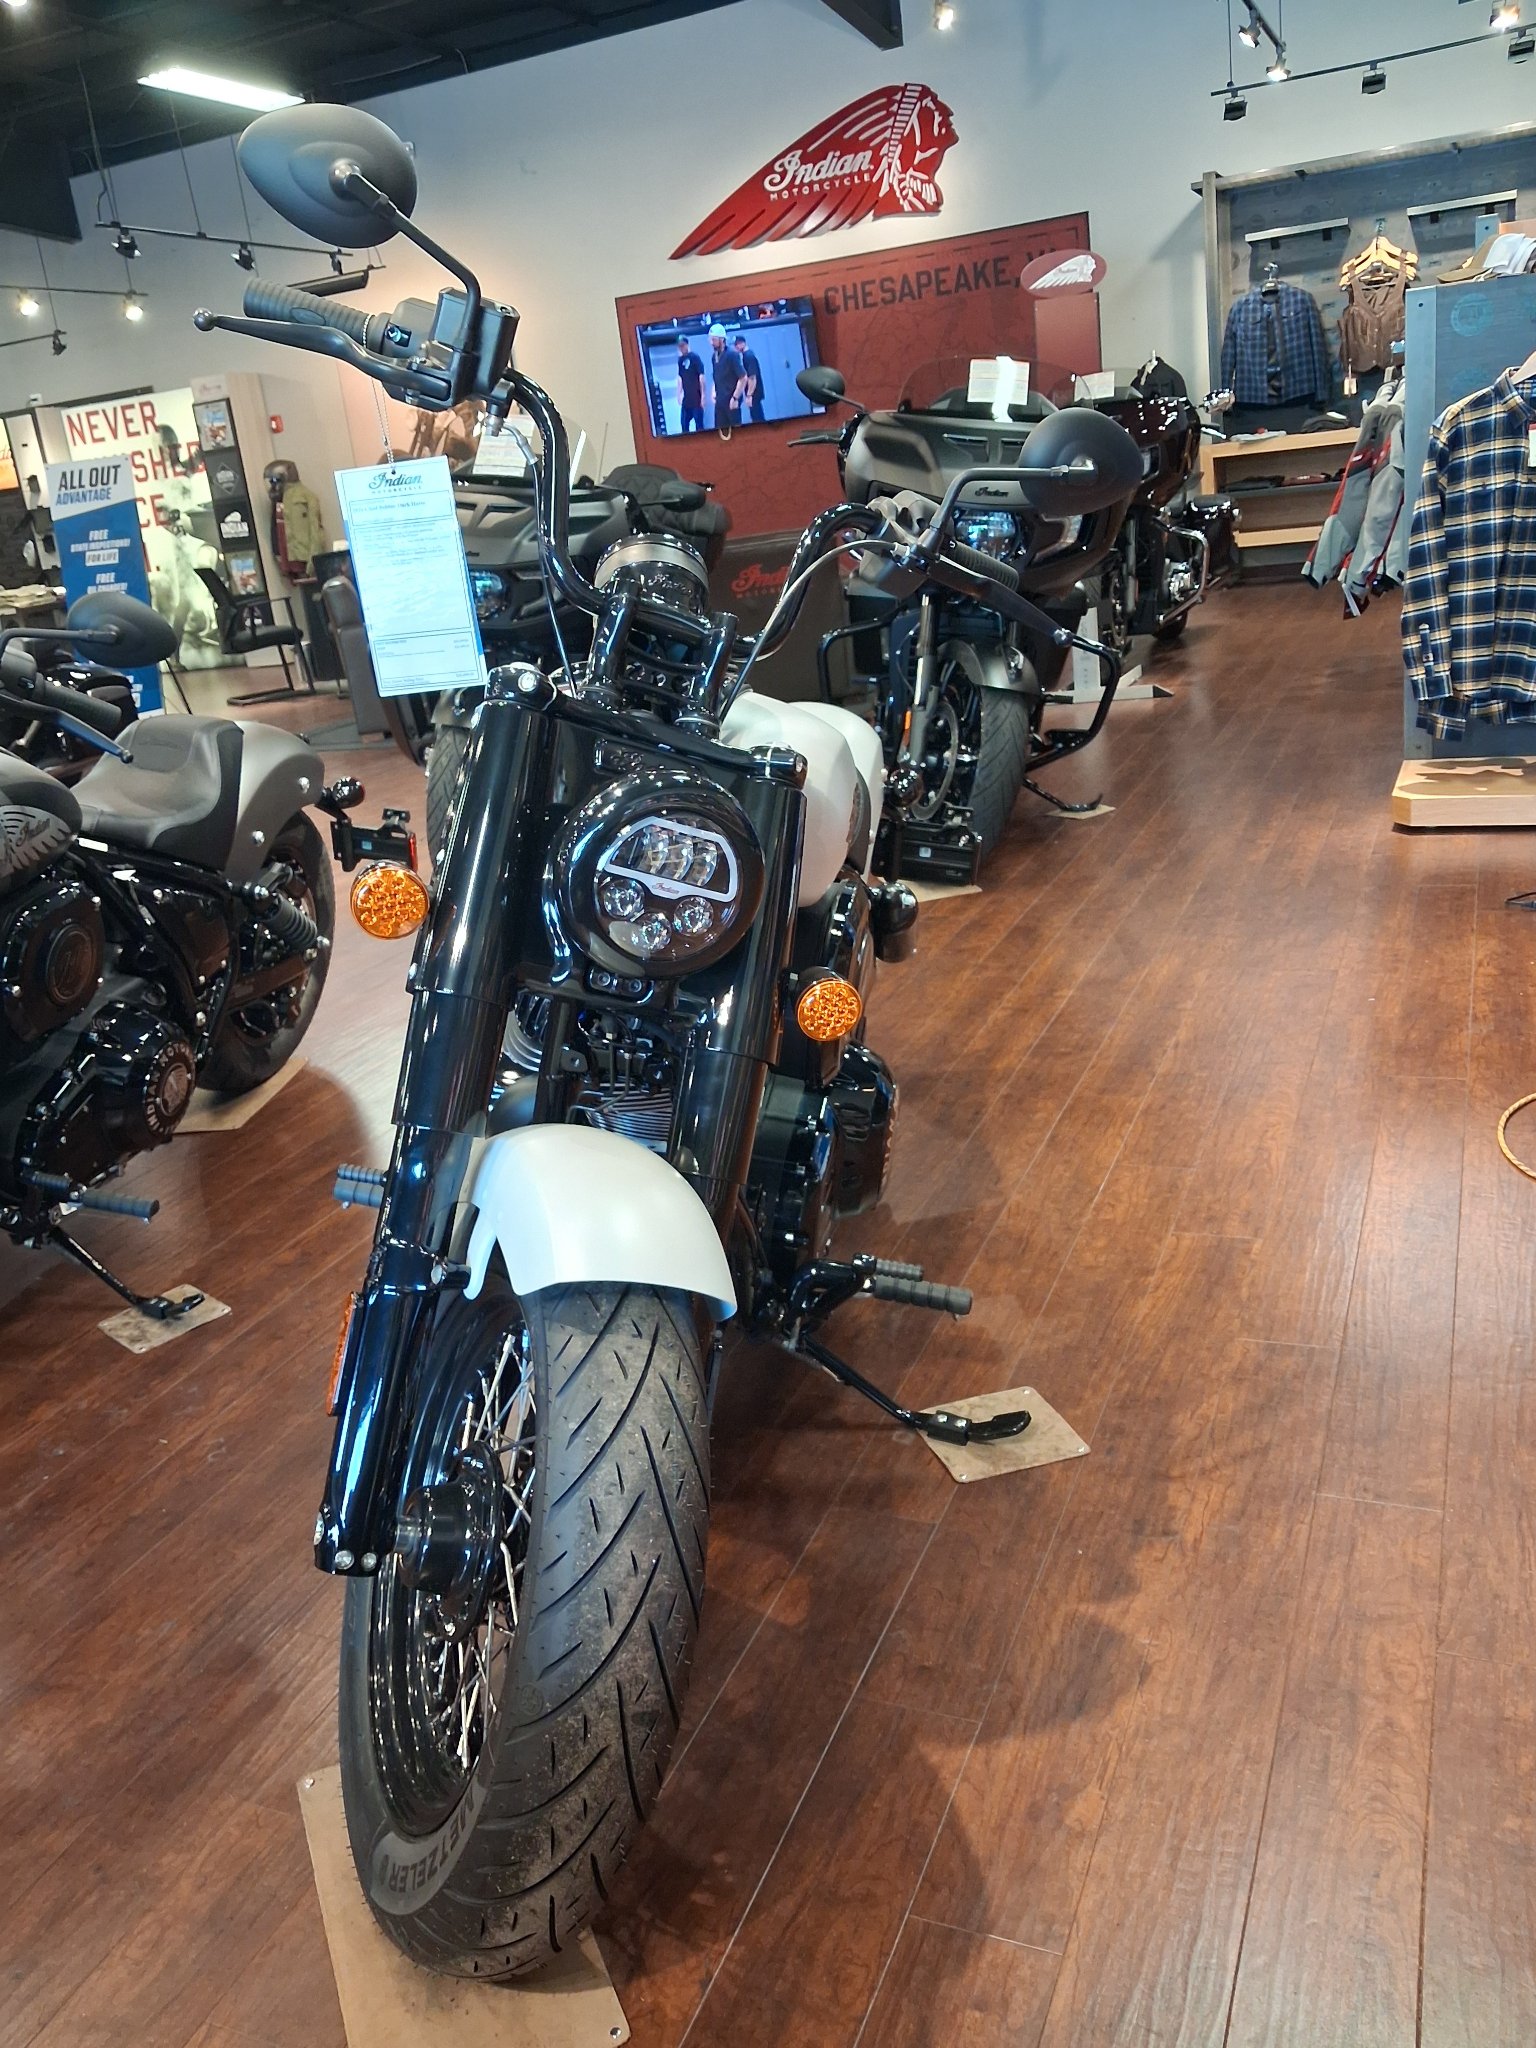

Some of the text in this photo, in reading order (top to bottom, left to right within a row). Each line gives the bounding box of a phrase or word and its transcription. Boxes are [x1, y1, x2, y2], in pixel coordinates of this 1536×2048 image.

[763, 149, 875, 192] Indian
[769, 172, 871, 201] MOTORCYCLE
[824, 256, 1021, 315] CHESAPEAKE,
[66, 401, 160, 446] NEVER
[58, 464, 122, 492] ALL OUT
[368, 471, 423, 490] Indian
[56, 487, 112, 507] ADVANTAGE
